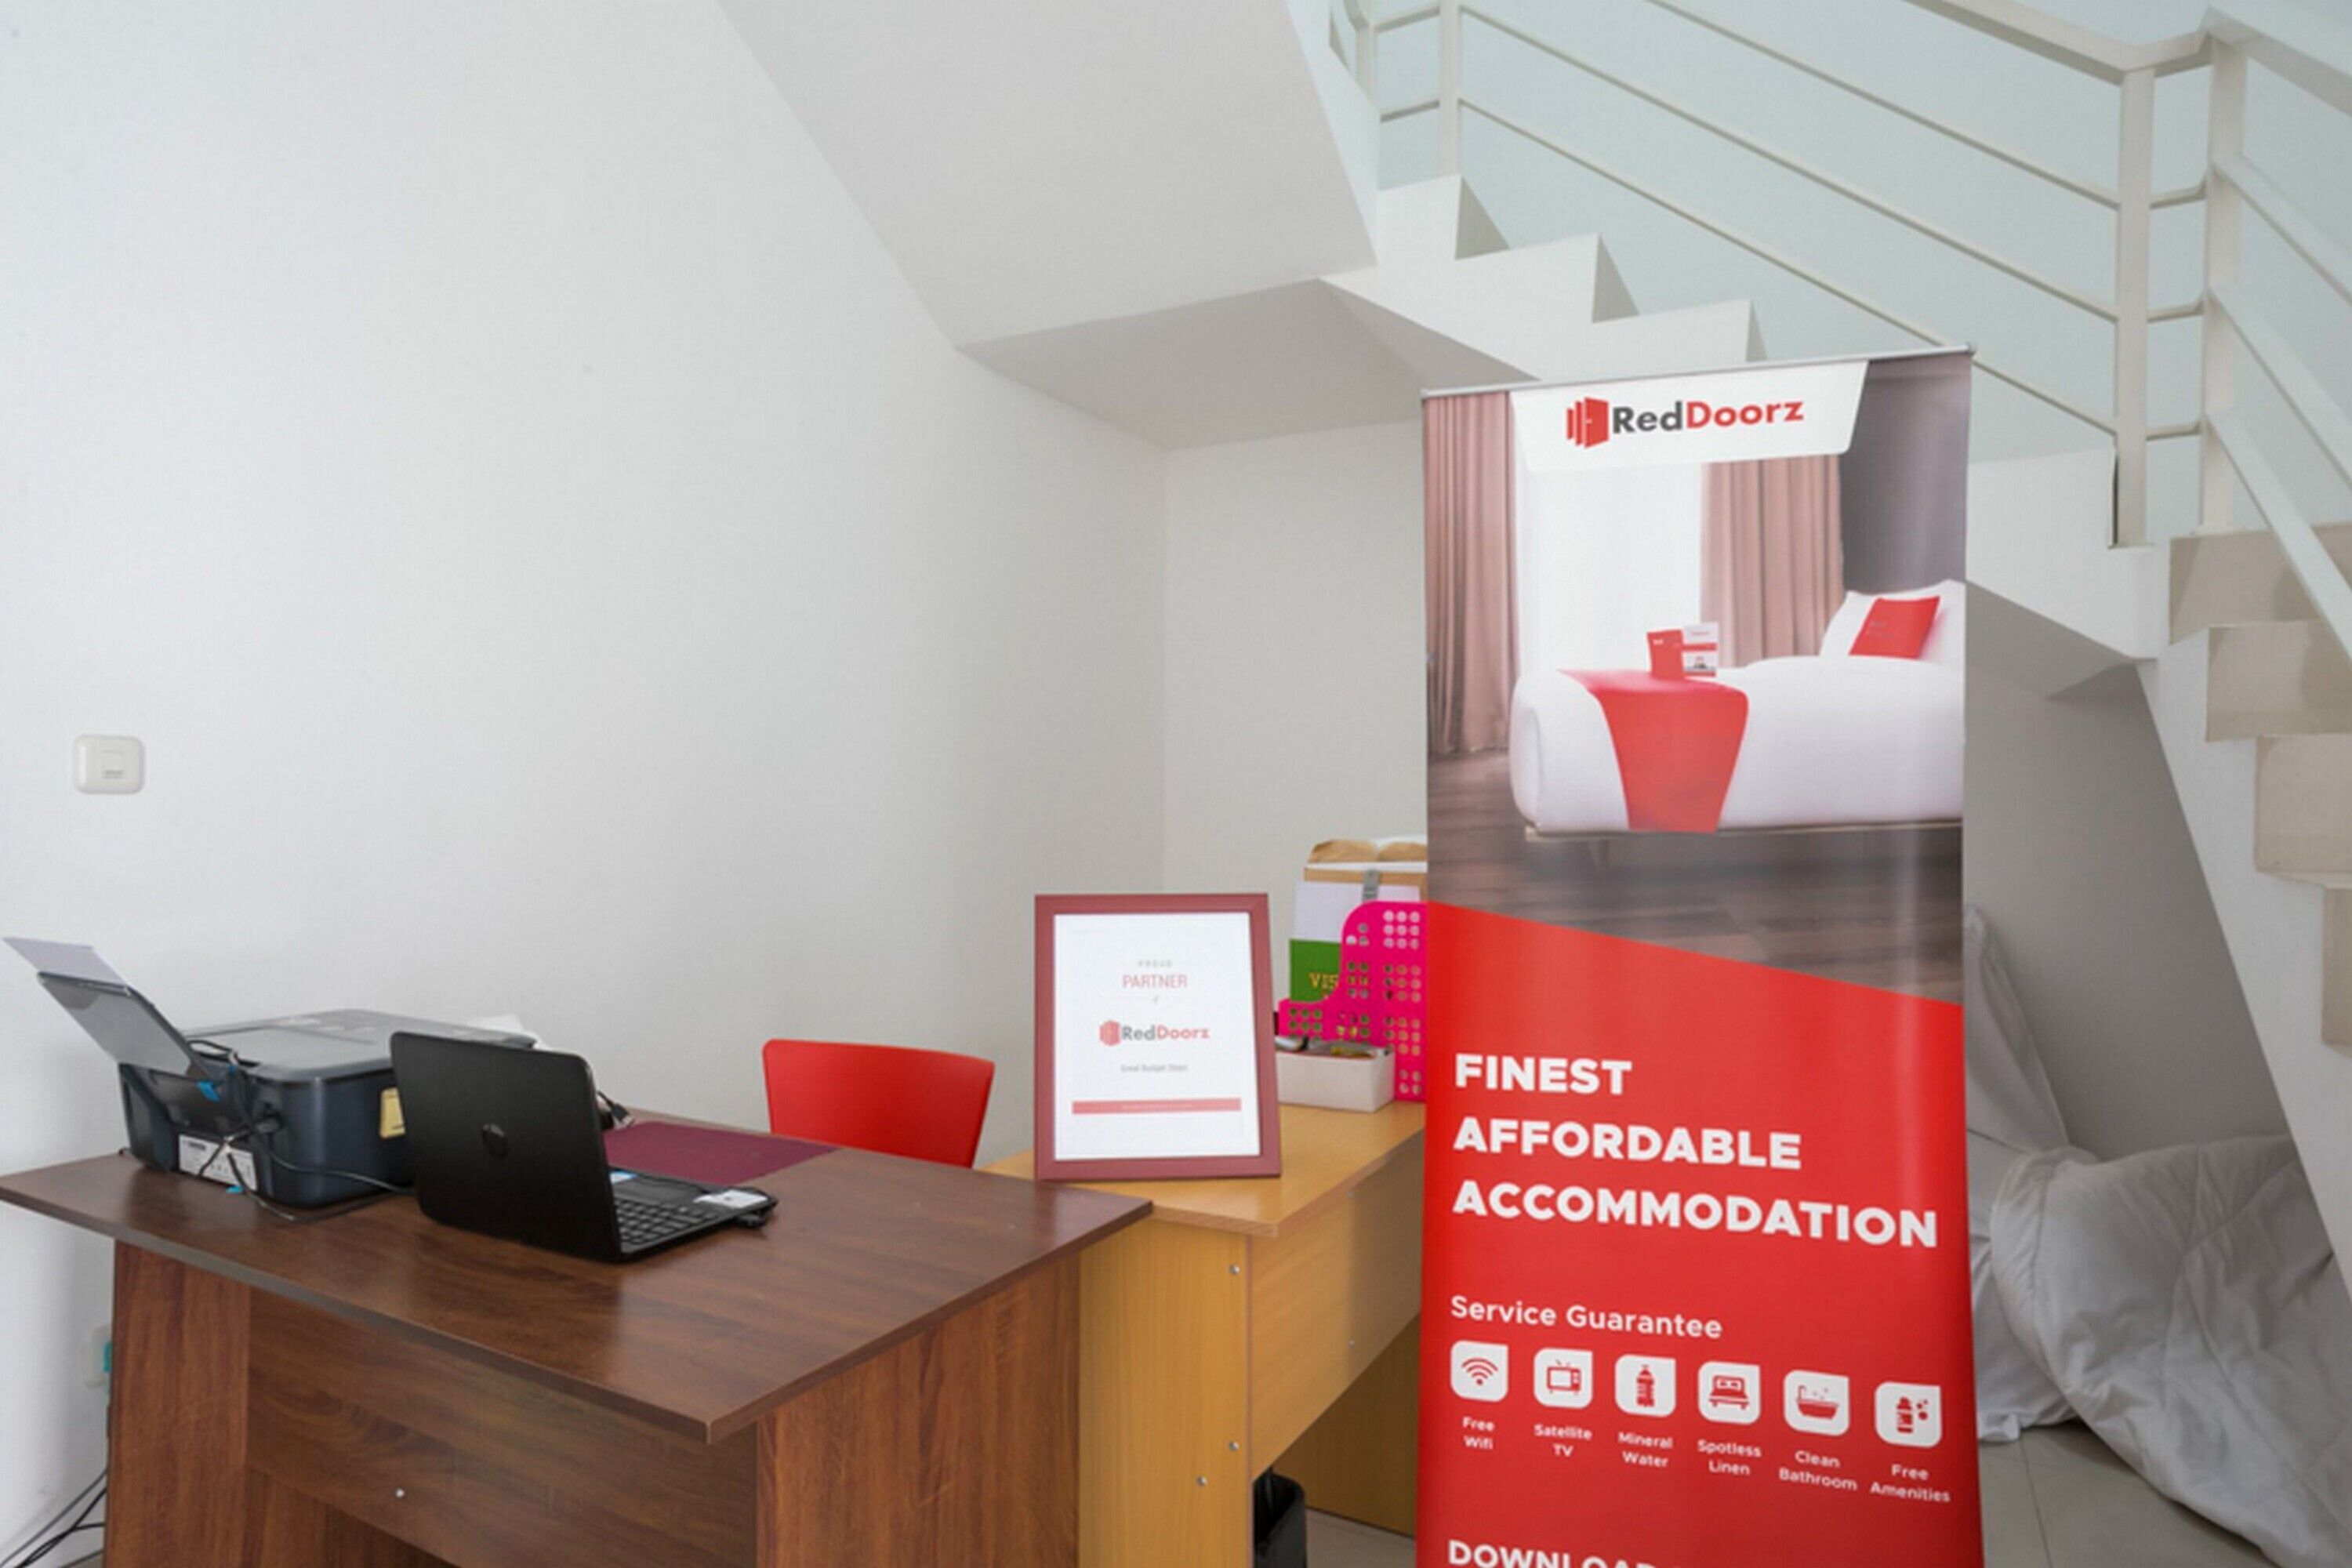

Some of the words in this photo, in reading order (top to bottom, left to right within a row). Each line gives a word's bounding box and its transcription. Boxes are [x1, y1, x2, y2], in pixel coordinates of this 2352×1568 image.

[1613, 401, 1804, 434] RedDoorz
[1122, 974, 1188, 989] PARTNER
[1122, 1023, 1210, 1041] RedDoorz
[1454, 1053, 1632, 1095] FINEST
[1454, 1116, 1802, 1170] AFFORDABLE
[1453, 1180, 1937, 1248] ACCOMMODATION
[1450, 1295, 1557, 1327] Service
[1566, 1305, 1723, 1339] Guarantee
[1462, 1416, 1494, 1432] Free
[1534, 1424, 1592, 1441] Satellite
[1464, 1435, 1494, 1450] Wifi
[1617, 1432, 1673, 1449] Mineral
[1697, 1439, 1762, 1458] Spotless
[1553, 1443, 1574, 1457] TV
[1622, 1450, 1669, 1468] Water
[1795, 1450, 1841, 1468] Clean
[1708, 1460, 1751, 1475] Linen
[1891, 1464, 1929, 1481] Free
[1778, 1468, 1858, 1490] Bathroom
[1869, 1482, 1951, 1503] Amenities
[1448, 1539, 1653, 1568] DOWNL
